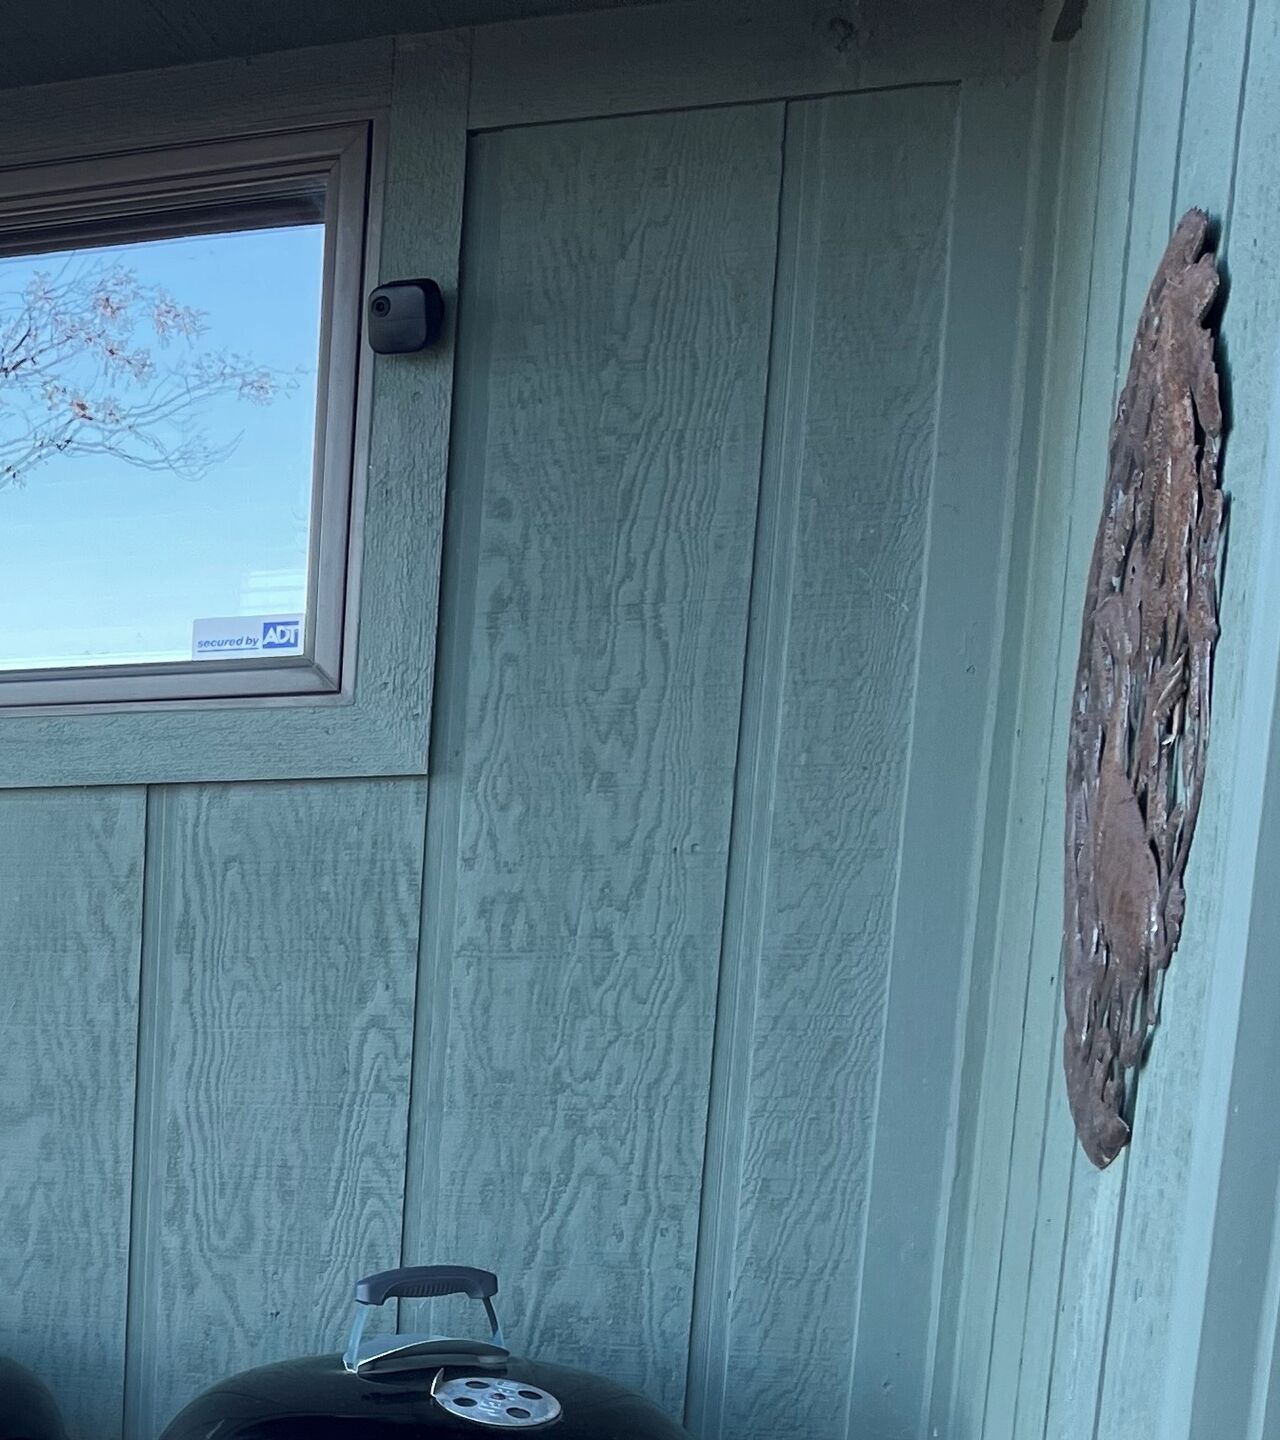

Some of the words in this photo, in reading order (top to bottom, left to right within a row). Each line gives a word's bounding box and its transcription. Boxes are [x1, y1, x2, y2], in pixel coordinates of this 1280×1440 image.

[197, 636, 243, 649] secured
[245, 636, 259, 647] by
[262, 625, 298, 645] ADT
